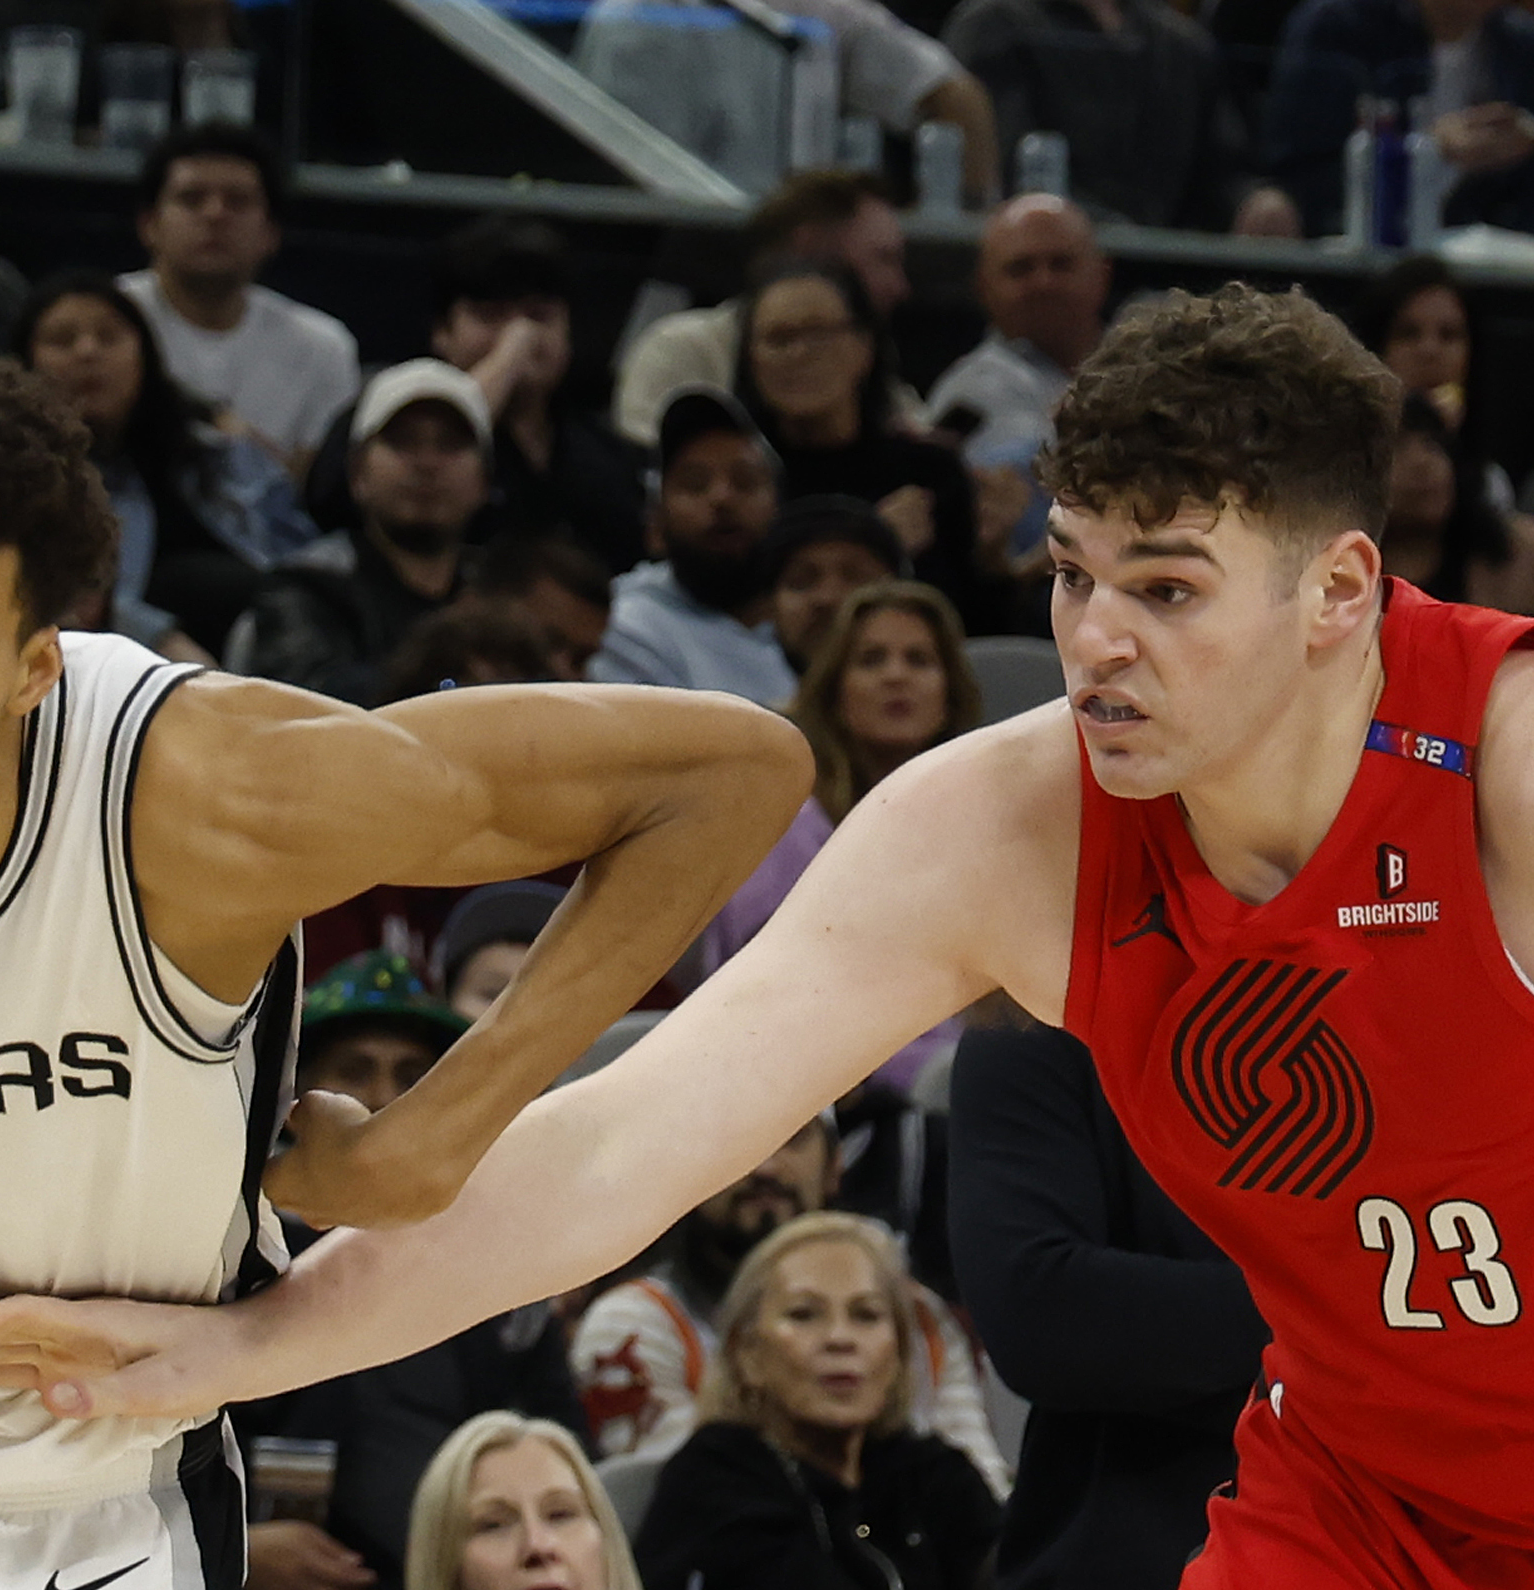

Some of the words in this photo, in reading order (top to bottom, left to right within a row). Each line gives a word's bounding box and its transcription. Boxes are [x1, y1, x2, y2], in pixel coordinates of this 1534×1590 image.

[1413, 735, 1447, 766] 32
[1387, 852, 1404, 890] B
[1337, 901, 1440, 929] BRIGHTSIDE
[1354, 1194, 1523, 1331] 23
